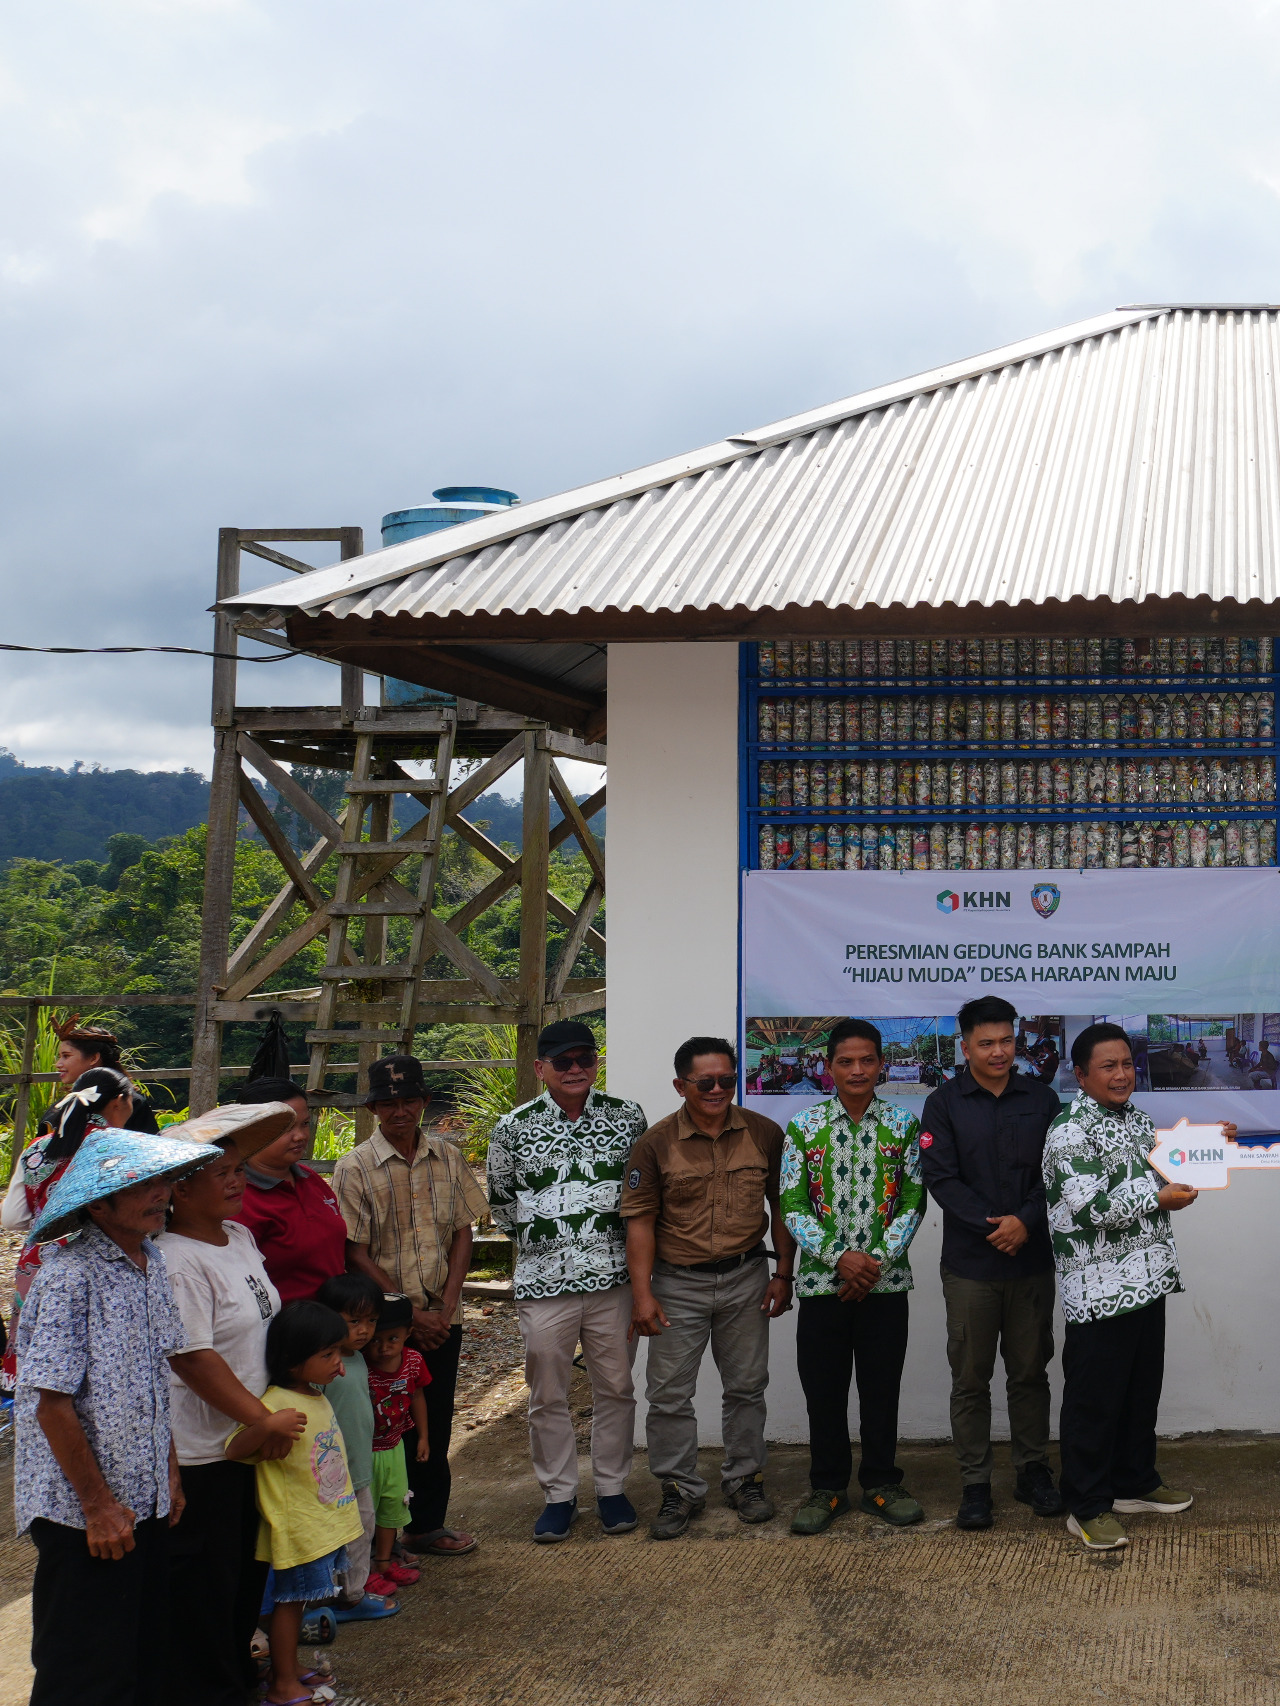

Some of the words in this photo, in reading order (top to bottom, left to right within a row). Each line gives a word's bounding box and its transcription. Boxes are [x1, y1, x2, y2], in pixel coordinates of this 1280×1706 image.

[963, 891, 1011, 908] KHN
[845, 944, 949, 960] PERESMIAN
[953, 943, 1032, 960] GEDUNG
[1037, 943, 1087, 959] BANK
[1091, 942, 1171, 959] SAMPAH
[981, 966, 1027, 982] DESA
[1031, 966, 1120, 982] HARAPAN
[1125, 965, 1177, 982] MAJU
[1188, 1149, 1224, 1161] KHN
